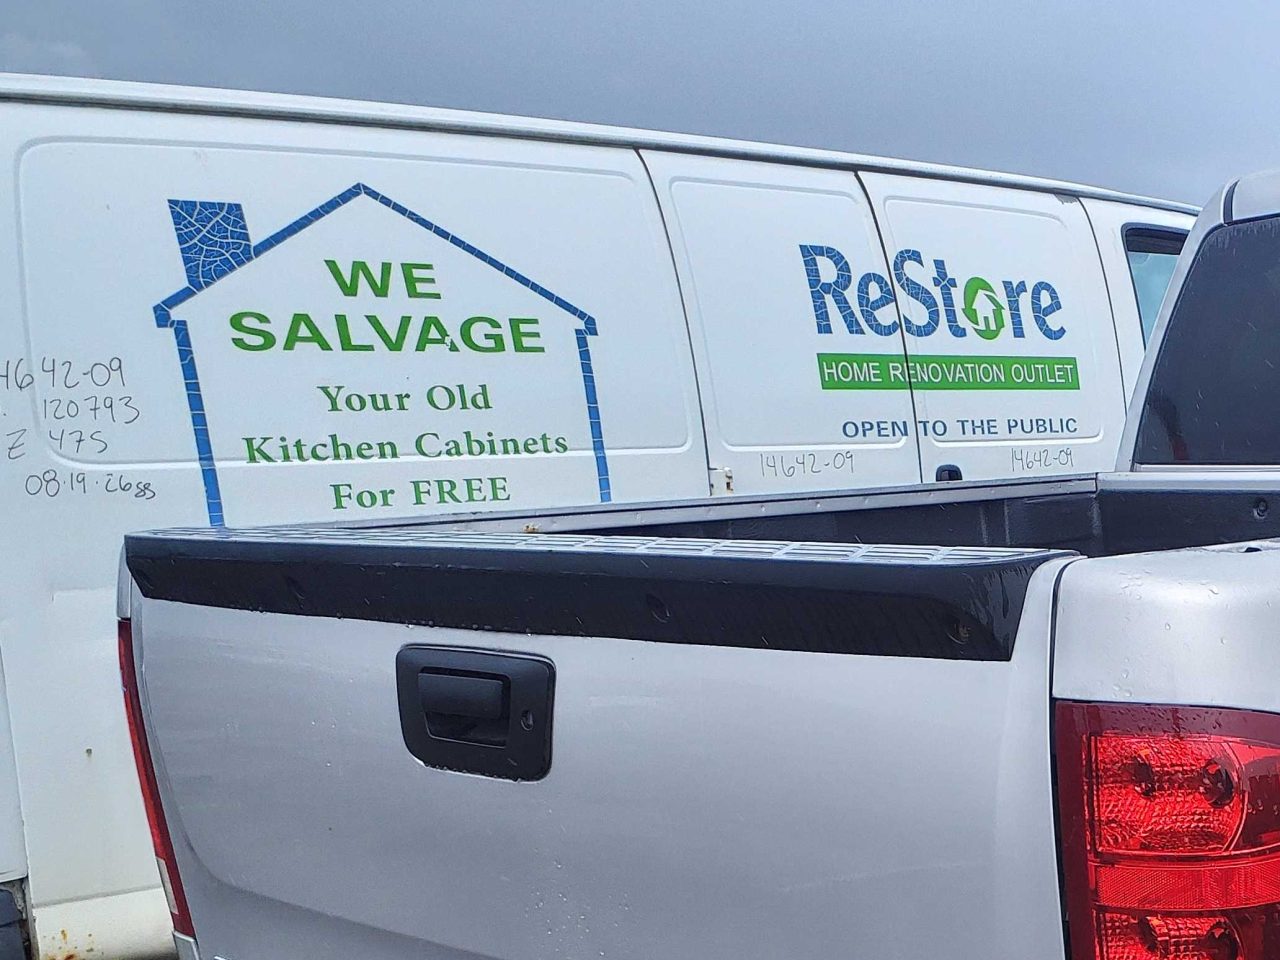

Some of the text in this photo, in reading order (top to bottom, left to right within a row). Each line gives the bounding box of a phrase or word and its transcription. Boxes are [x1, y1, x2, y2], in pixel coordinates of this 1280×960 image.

[324, 259, 441, 299] WE
[799, 244, 1067, 341] ReStore
[229, 311, 546, 353] SALVAGE
[823, 361, 1074, 384] HOME RENOVATION OUTLET
[317, 384, 493, 412] Your Old
[842, 417, 1078, 438] OPEN TO THE PUBLIC
[242, 430, 569, 465] Kitchen Cabinets
[1011, 447, 1074, 472] 14642-09
[760, 450, 855, 478] 14642-09
[329, 476, 511, 510] For FREE
